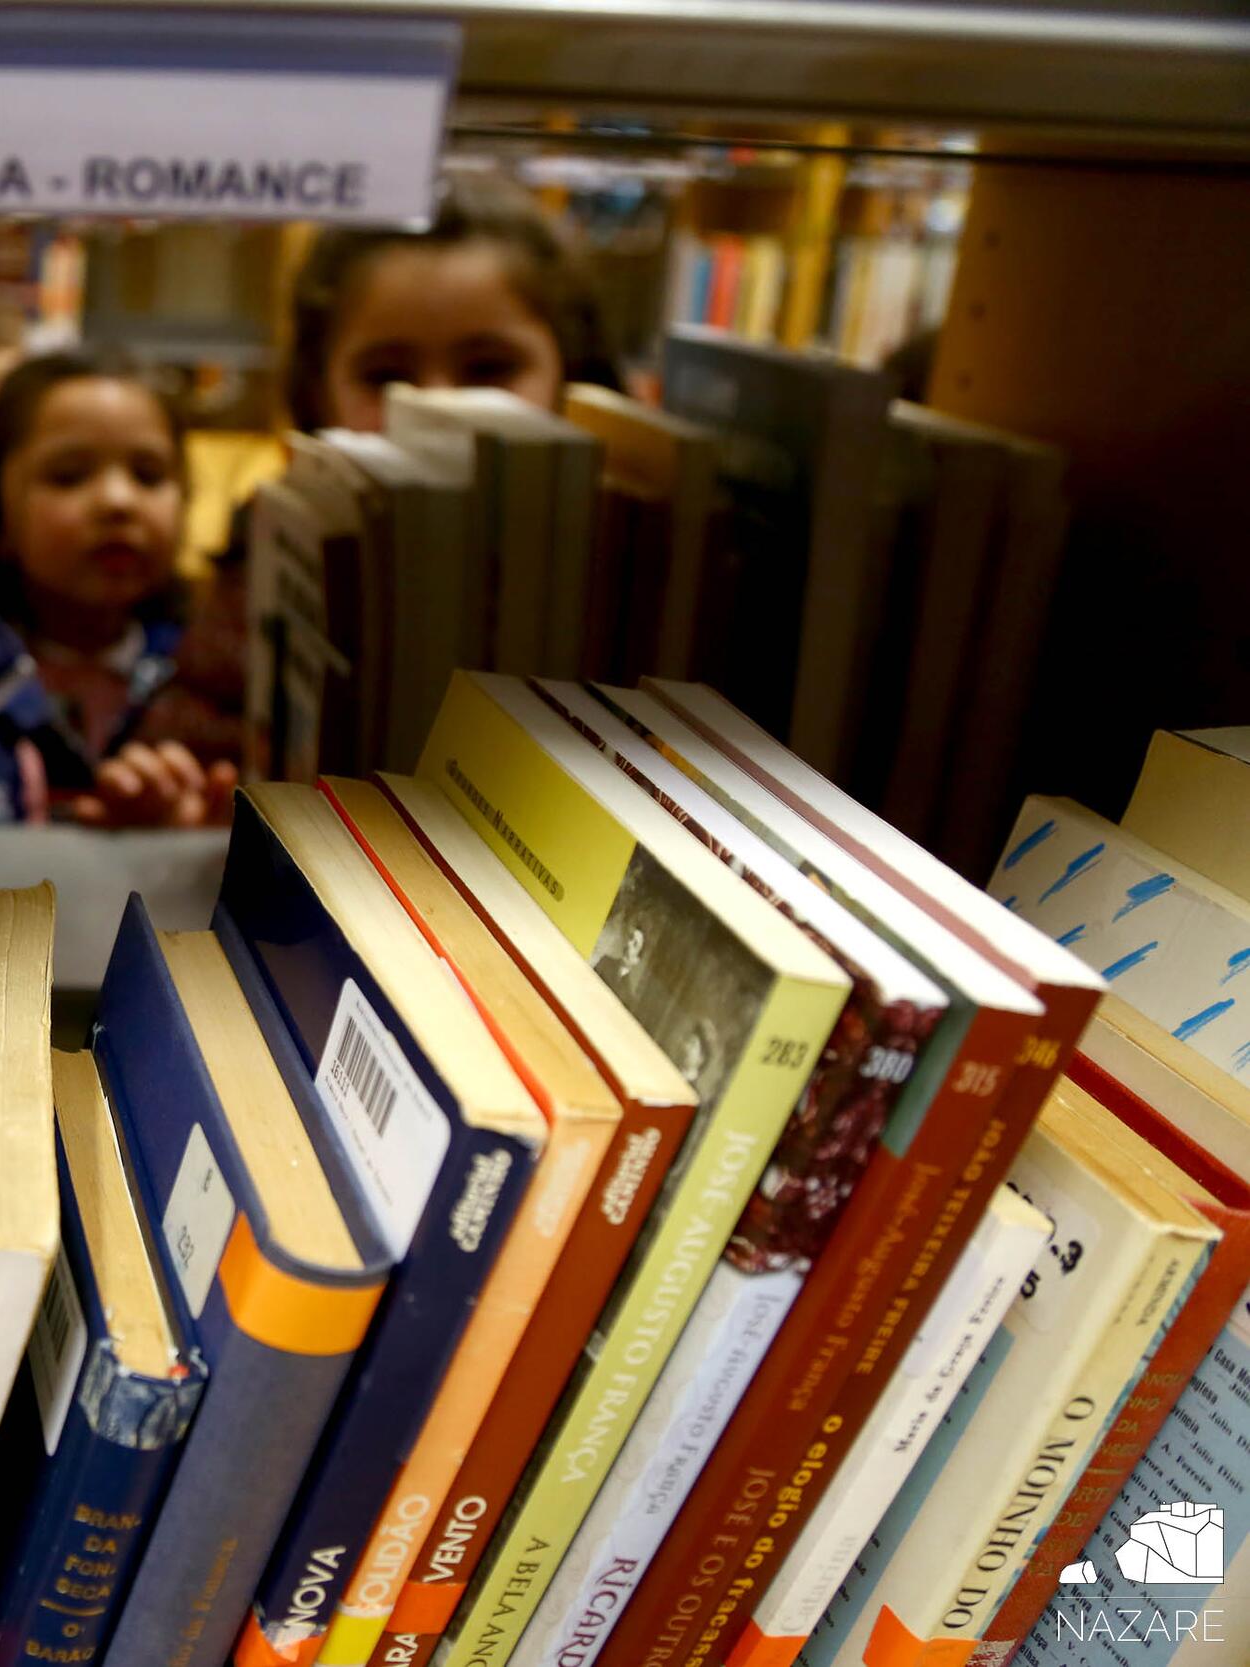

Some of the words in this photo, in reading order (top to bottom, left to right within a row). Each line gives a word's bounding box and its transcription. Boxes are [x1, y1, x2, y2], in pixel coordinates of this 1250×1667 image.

[85, 157, 368, 207] ROMANCE
[493, 809, 560, 896] NARRATIVAS
[902, 1193, 972, 1294] TEIXEIRA
[855, 1296, 914, 1375] FREIRE
[559, 1373, 639, 1483] FRANÇA
[821, 1415, 844, 1435] o
[1063, 1396, 1096, 1421] O
[767, 1442, 830, 1528] elogio
[977, 1436, 1077, 1572] MOINHO
[357, 1493, 432, 1606] OLIDÃO
[422, 1495, 489, 1584] VENTO
[691, 1554, 727, 1589] OS
[744, 1537, 776, 1570] do
[283, 1545, 347, 1628] NOVA
[492, 1560, 541, 1617] BELA
[942, 1588, 991, 1630] DO
